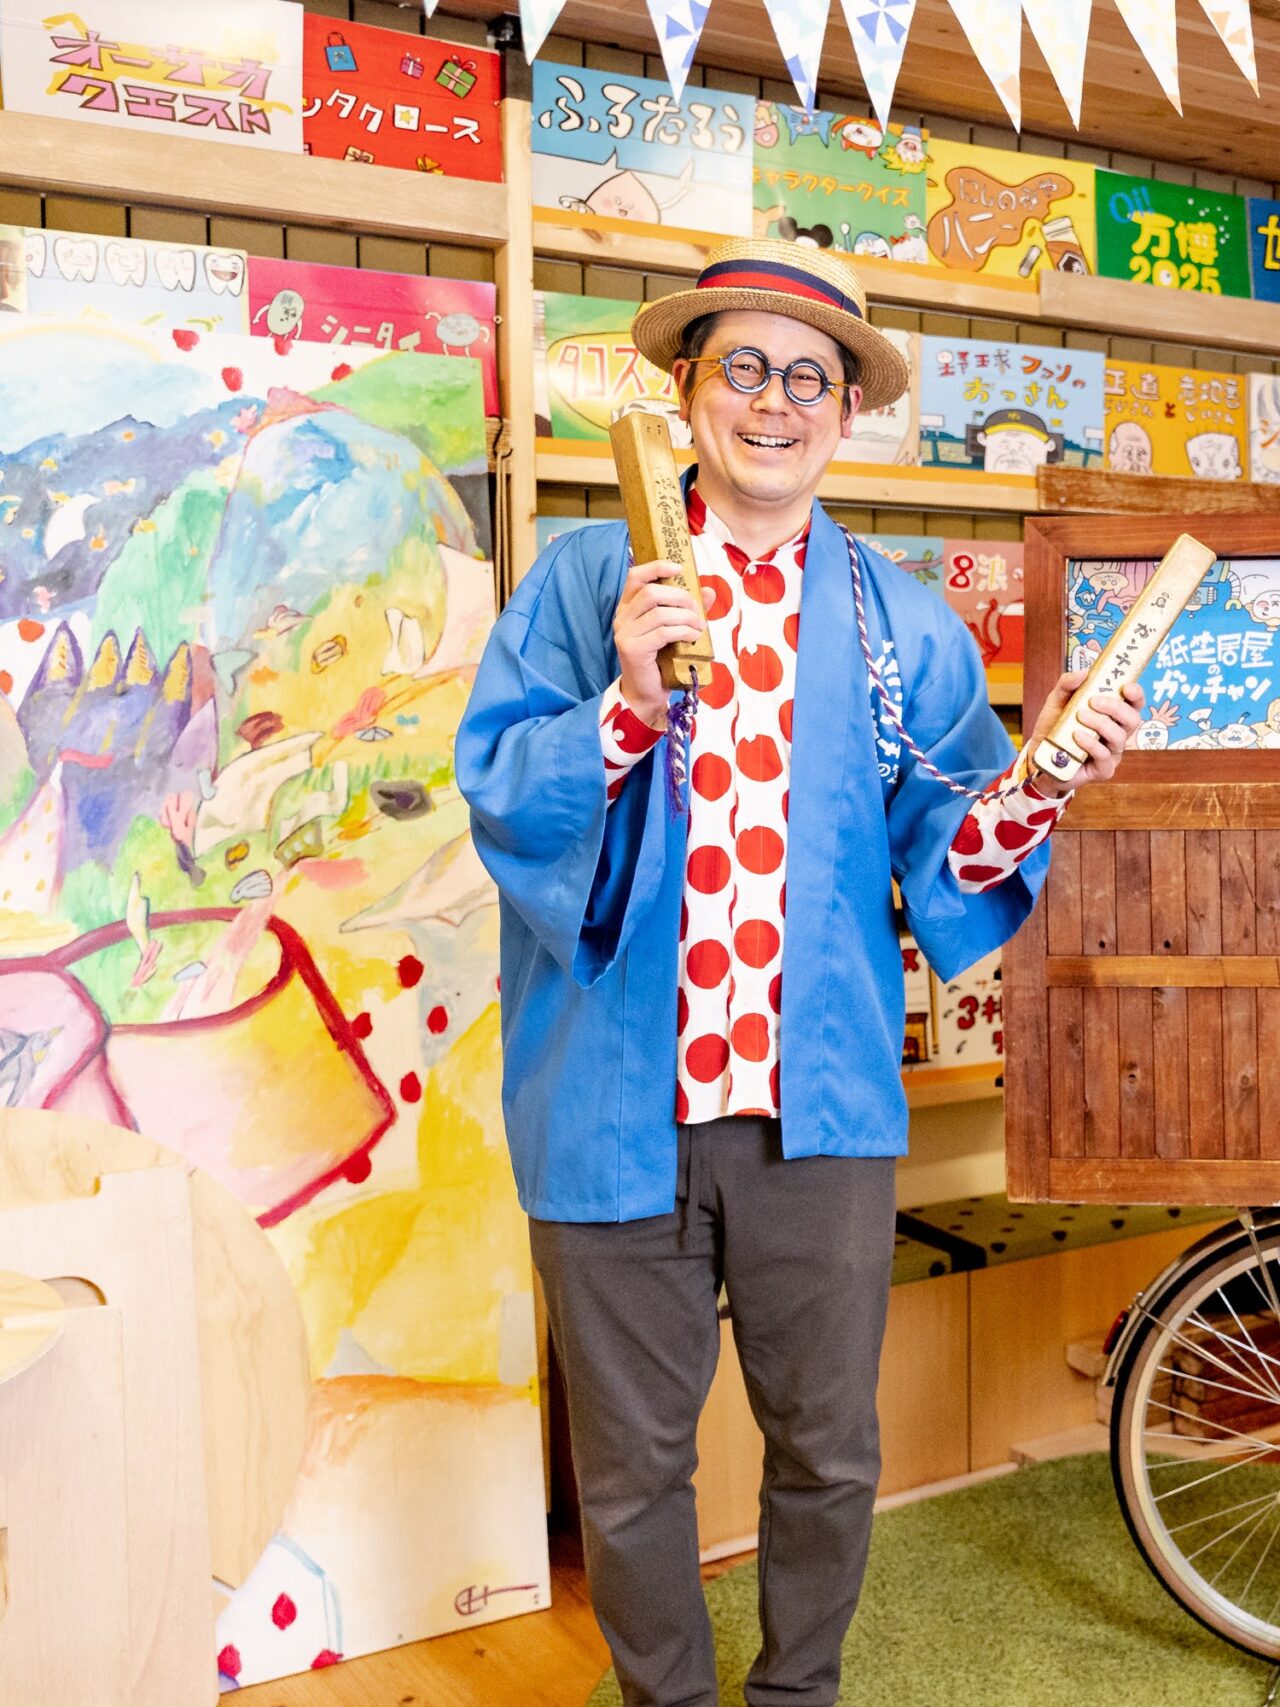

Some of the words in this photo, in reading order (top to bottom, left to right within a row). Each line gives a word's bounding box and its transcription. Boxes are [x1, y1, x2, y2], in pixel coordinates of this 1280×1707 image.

[49, 30, 274, 100] オーサカ
[57, 73, 272, 135] クエスト
[1130, 211, 1219, 265] 万博
[1129, 255, 1222, 296] 2025
[963, 376, 1069, 410] おっさん
[1155, 630, 1274, 669] 紙芝居屋
[1208, 663, 1221, 676] の
